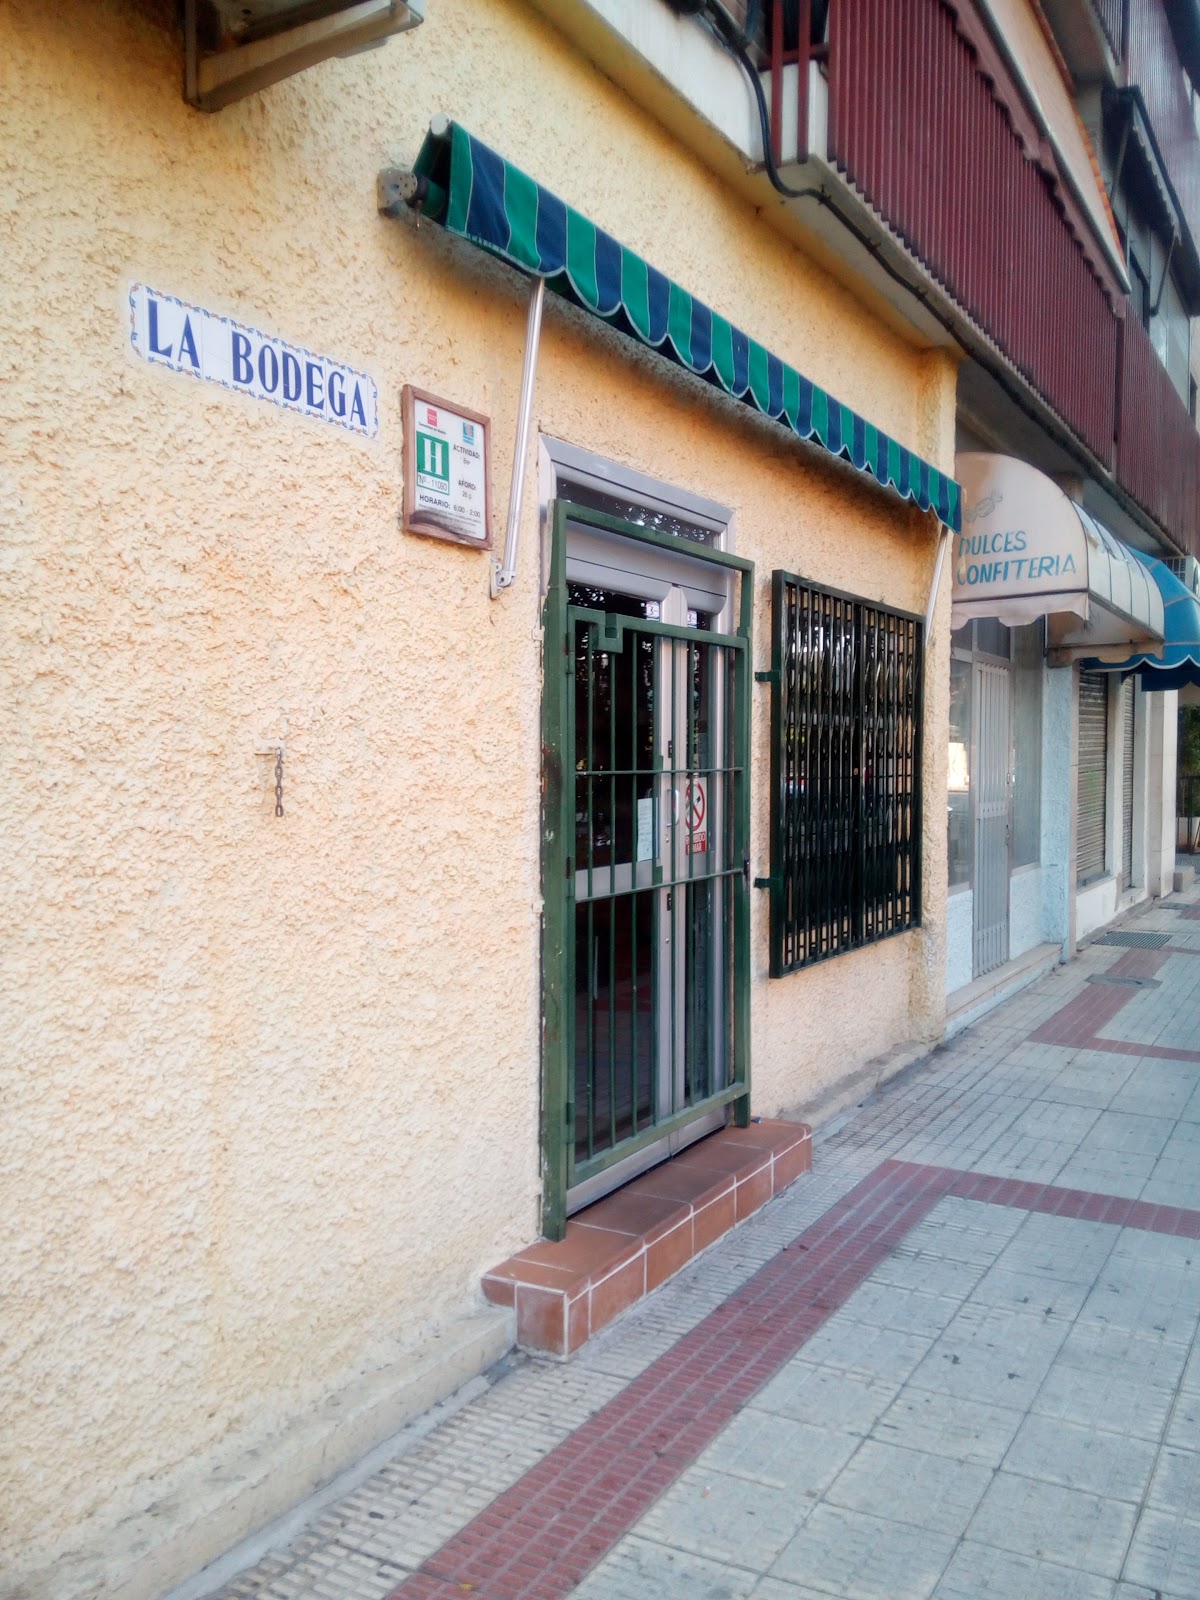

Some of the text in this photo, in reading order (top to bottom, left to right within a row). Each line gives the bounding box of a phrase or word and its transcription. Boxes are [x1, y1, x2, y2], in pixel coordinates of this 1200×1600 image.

[147, 298, 367, 427] LA BODEGA
[422, 437, 444, 477] H
[453, 444, 480, 459] ACTIVIDAD:
[431, 479, 448, 492] 11093
[458, 479, 477, 492] AFORO:
[419, 493, 451, 509] HORARIO:
[453, 504, 466, 514] 6:00
[469, 509, 481, 518] 2:00
[958, 530, 1027, 558] DULCES
